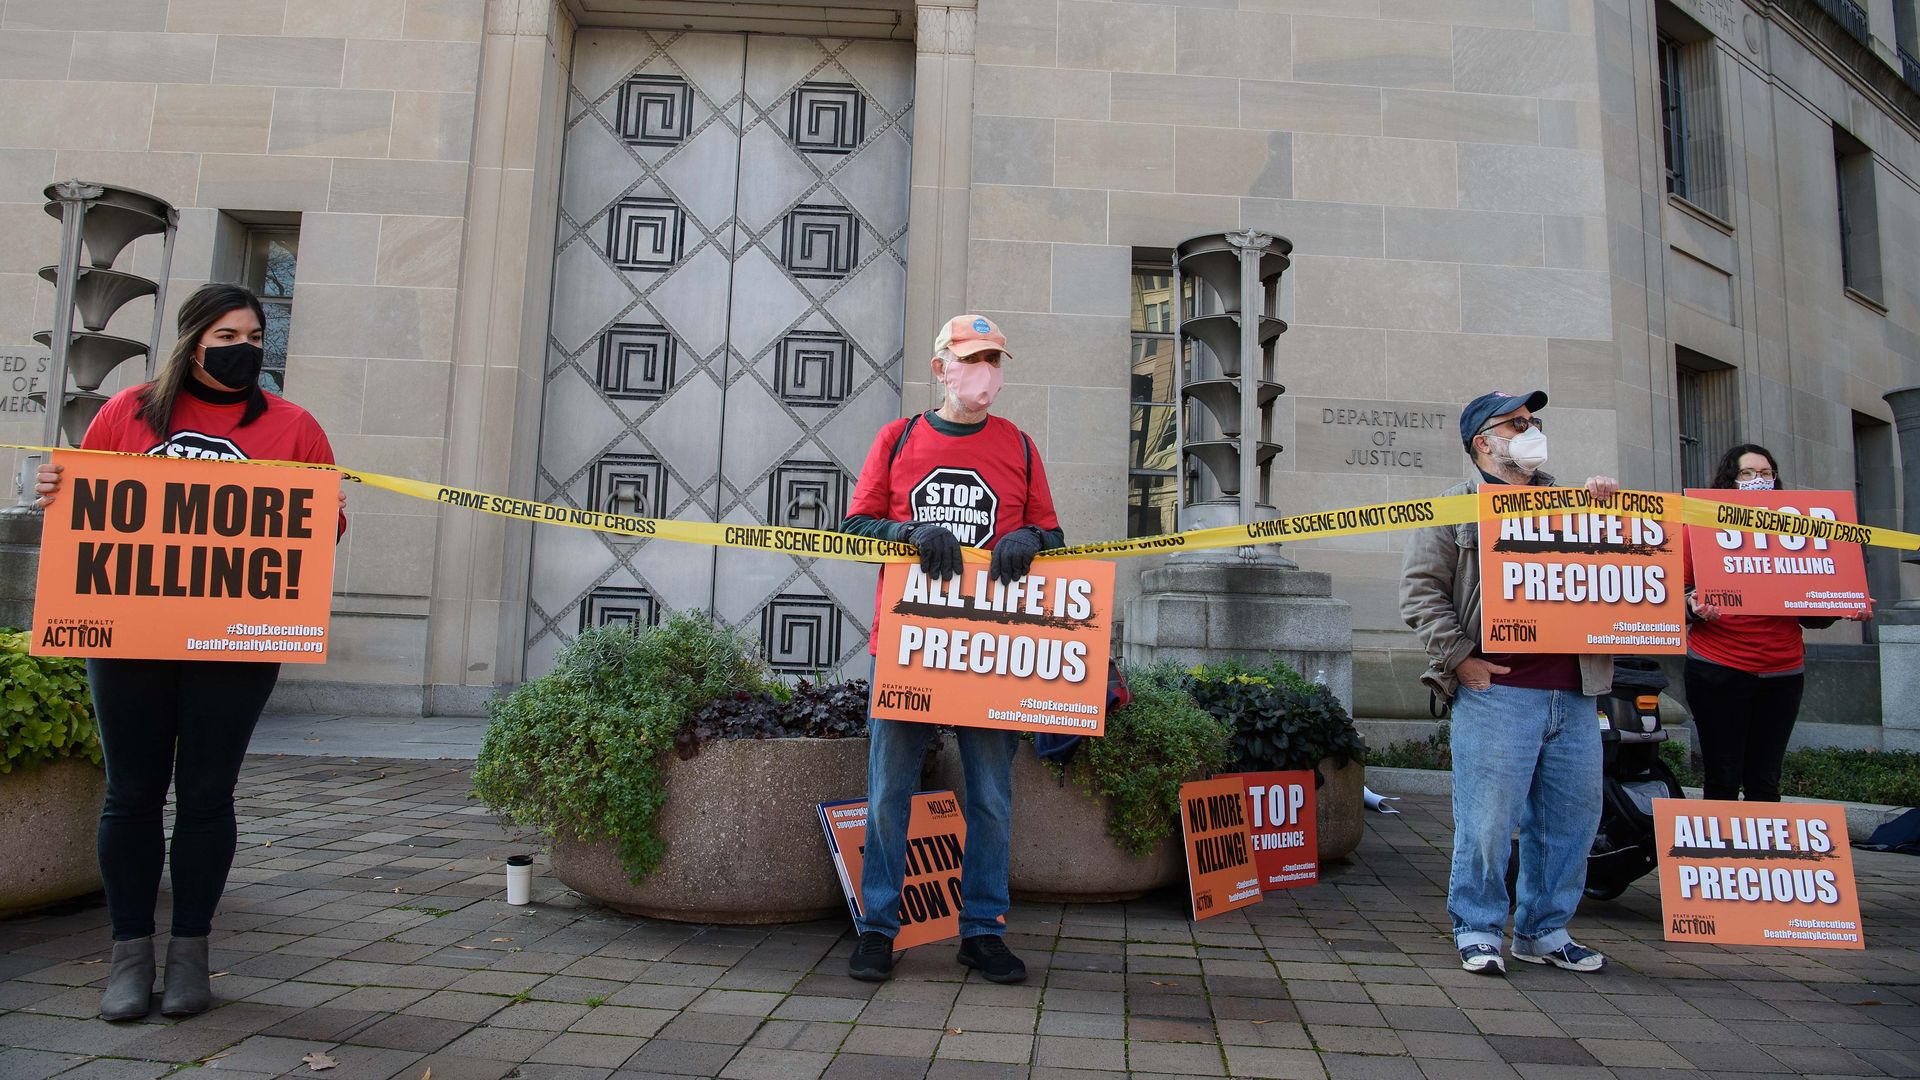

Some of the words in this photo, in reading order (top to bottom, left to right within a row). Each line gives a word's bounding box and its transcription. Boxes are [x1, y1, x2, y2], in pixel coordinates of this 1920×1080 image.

[0, 356, 26, 373] ED
[12, 376, 39, 392] OF
[1321, 407, 1447, 430] DEPARTMENT
[1371, 431, 1397, 447] OF
[166, 443, 238, 460] ST
[1345, 449, 1424, 468] JUSTICE
[925, 482, 984, 508] STOP
[1492, 491, 1534, 514] CRIME
[1534, 489, 1575, 510] SCENE
[1622, 492, 1664, 515] CROSS
[71, 477, 148, 533] NO
[161, 482, 315, 539] MORE
[437, 488, 490, 510] CRIME
[491, 497, 541, 518] SCENE
[544, 506, 567, 522] DO
[569, 510, 602, 527] NOT
[604, 515, 656, 534] CROSS
[917, 506, 990, 526] EXECUTIONS
[1246, 518, 1292, 539] CRIME
[1292, 512, 1337, 533] SCENE
[1337, 510, 1357, 529] DO
[1358, 506, 1387, 527] NOT
[1387, 501, 1434, 524] CROSS
[1500, 512, 1555, 542] ALL
[1562, 511, 1624, 545] LIFE
[1631, 514, 1664, 546] IS
[1717, 504, 1753, 528] CRIME
[1755, 510, 1791, 533] SCENE
[1792, 517, 1810, 536] DO
[1810, 520, 1834, 539] NOT
[1834, 523, 1872, 544] CROSS
[725, 526, 772, 548] CRIME
[774, 530, 821, 552] SCENE
[823, 535, 843, 553] DO
[846, 537, 876, 556] NOT
[932, 522, 977, 545] W!
[75, 541, 303, 600] KILLING!
[1723, 556, 1773, 574] STATE
[1774, 556, 1836, 575] KILLING
[902, 563, 965, 608] ALL
[974, 570, 1047, 616] LIFE
[1053, 577, 1092, 620] IS
[1502, 561, 1666, 604] PRECIOUS
[1704, 592, 1743, 607] ACTION
[1806, 591, 1865, 600] #StopExecutions
[47, 618, 75, 626] DEATH
[77, 618, 115, 626] PENALTY
[226, 623, 325, 637] #StopExecutions
[1612, 621, 1681, 633] #StopExecutions
[42, 625, 112, 648] ACTION
[1490, 624, 1537, 642] ACTION
[1587, 634, 1681, 647] DeathPenaltyAction.org
[187, 637, 324, 653] DeathPenaltyAction.org
[898, 624, 1088, 683] PRECIOUS
[881, 683, 903, 691] DEATH
[904, 685, 934, 693] PENALTY
[877, 690, 932, 713] ACTION
[1020, 698, 1099, 715] #StopExecutions
[987, 708, 1098, 730] DeathPenaltyAction.org
[926, 799, 957, 815] ACTION
[1188, 797, 1208, 834] NO
[1207, 793, 1244, 830] MORE
[1249, 783, 1304, 828] TOP
[1261, 831, 1305, 850] VIOLENCE
[1674, 815, 1726, 849] ALL
[1730, 817, 1792, 851] LIFE
[1796, 819, 1831, 853] IS
[1194, 832, 1249, 875] KILLING!
[1678, 865, 1839, 904] PRECIOUS
[1672, 919, 1716, 935] ACTION
[1788, 918, 1856, 930] #StopExecutions
[1764, 929, 1858, 942] DeathPenaltyAction.org
